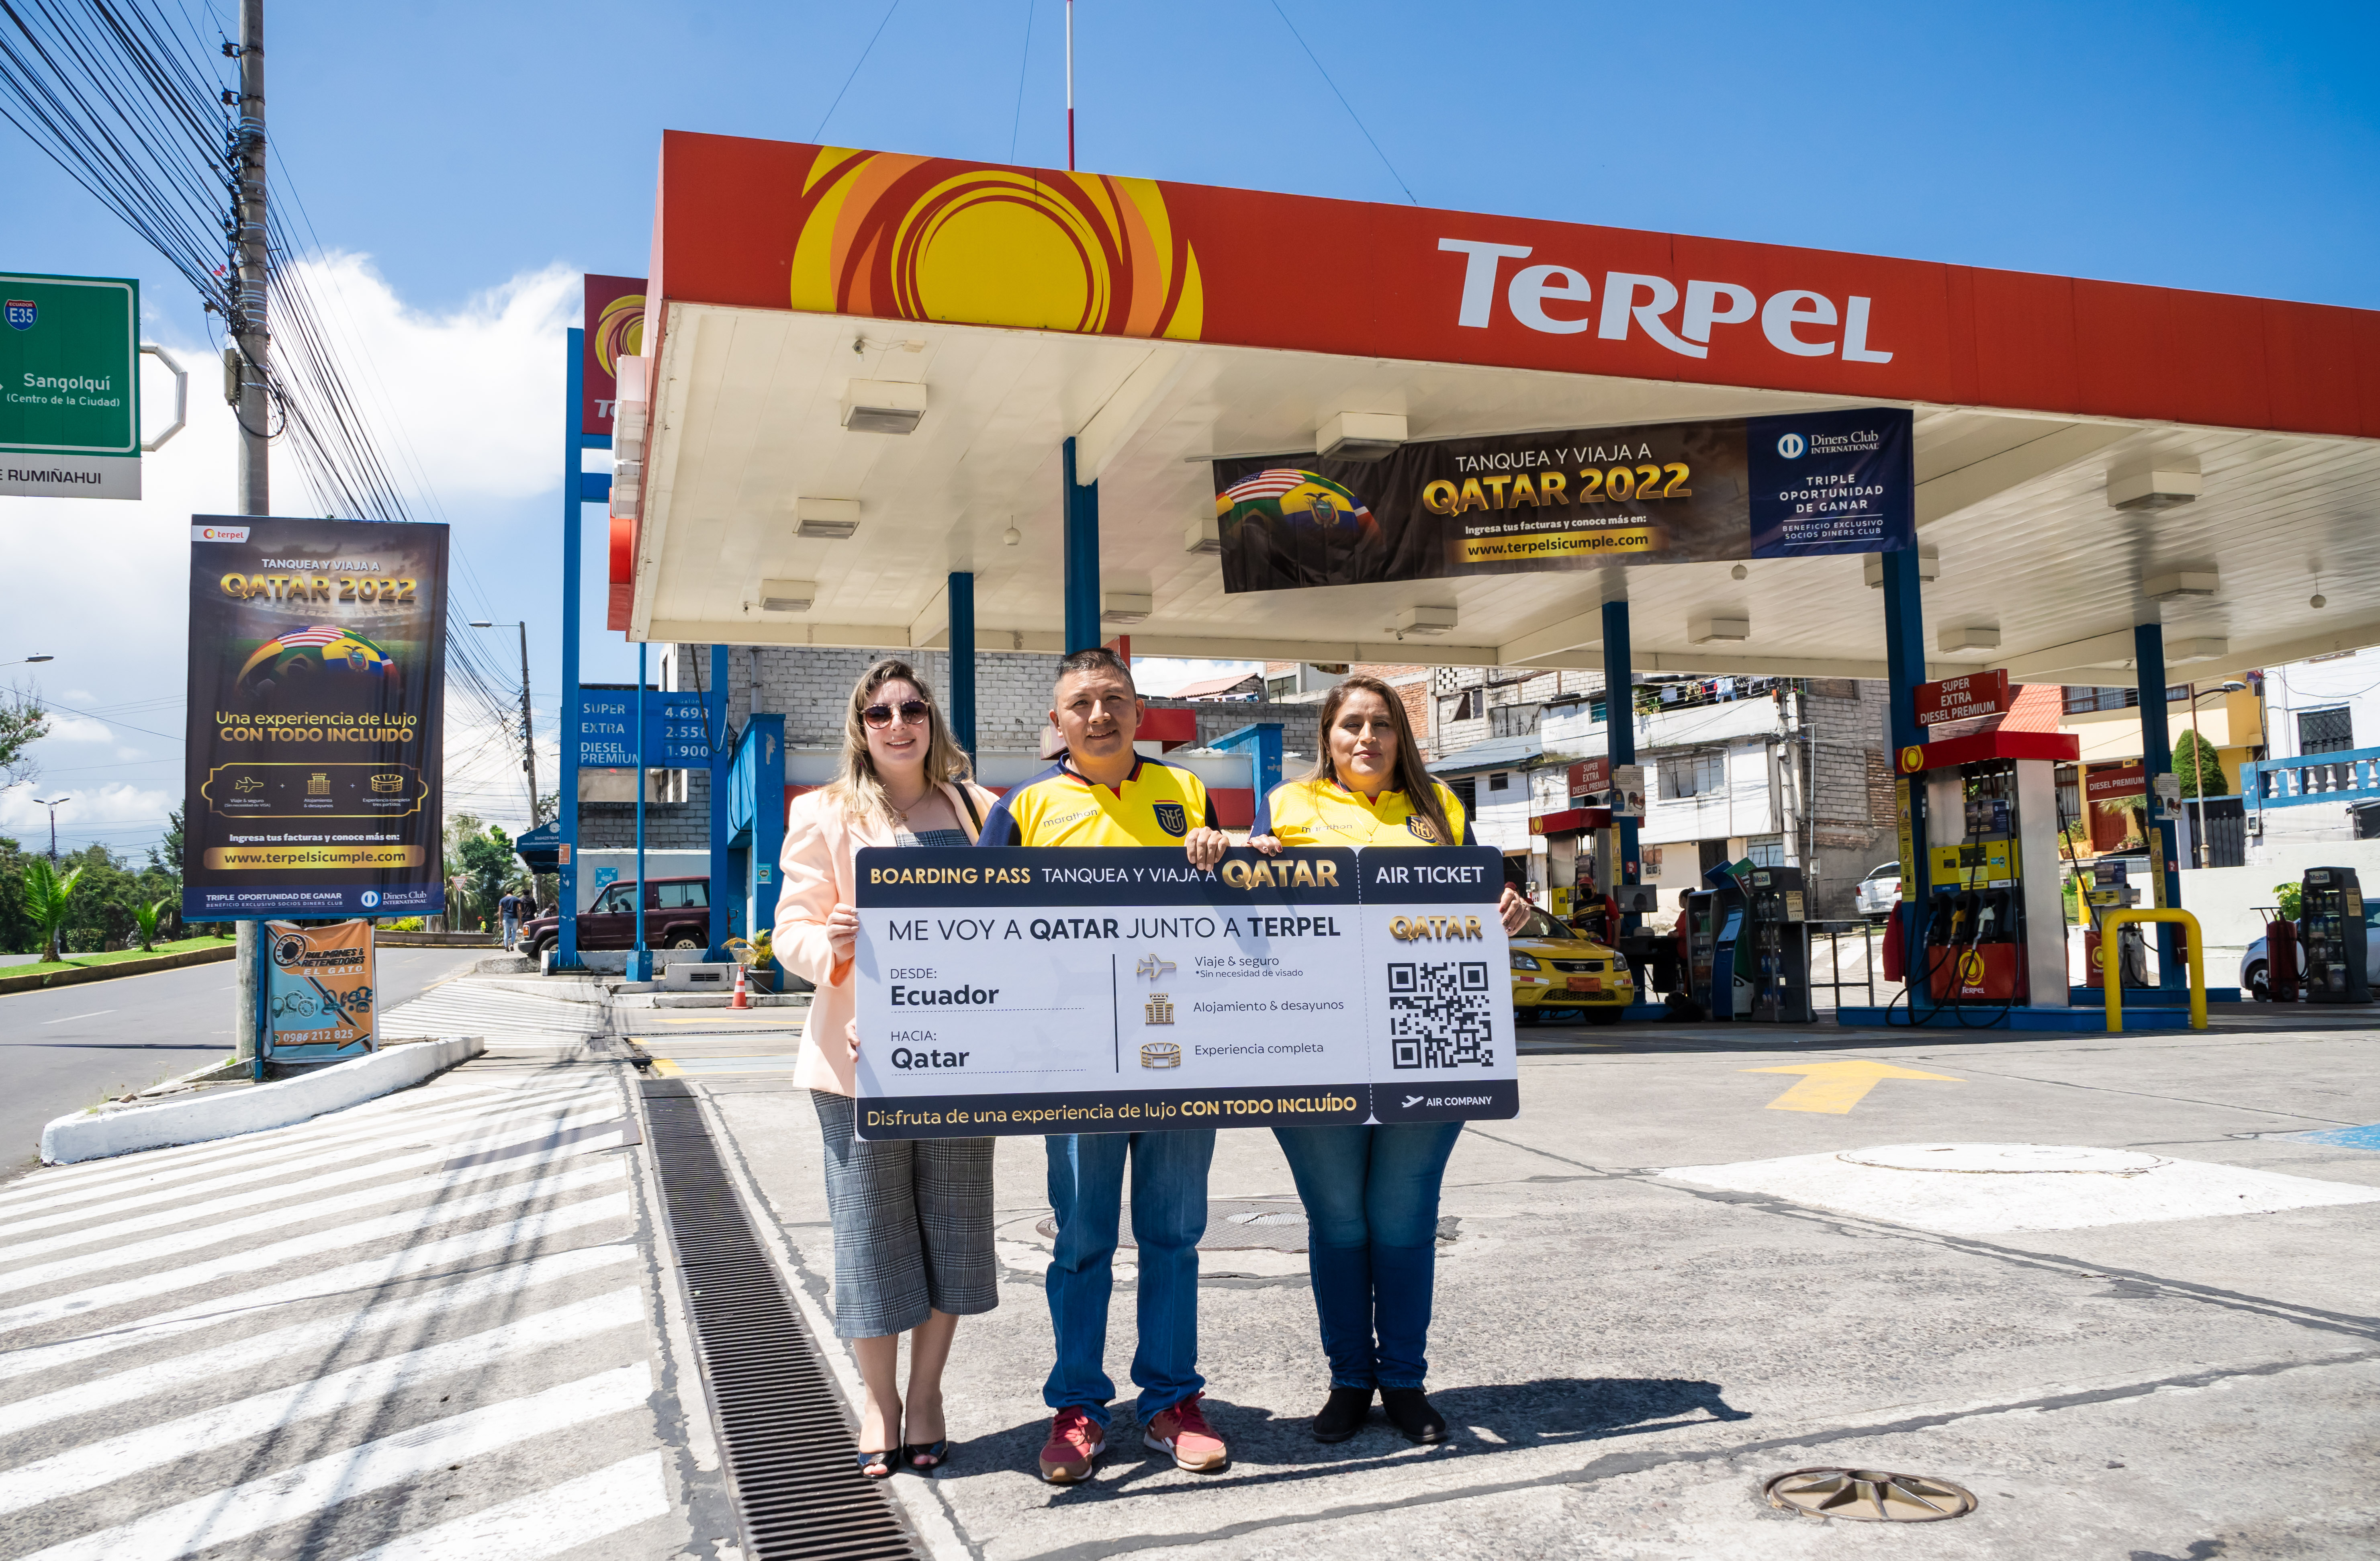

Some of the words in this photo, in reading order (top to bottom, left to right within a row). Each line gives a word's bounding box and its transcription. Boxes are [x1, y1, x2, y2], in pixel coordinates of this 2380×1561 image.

[10, 308, 33, 323] E35
[24, 373, 110, 393] Sangolquí
[7, 394, 47, 403] (Centro
[51, 396, 63, 404] de
[67, 396, 76, 405] la
[79, 397, 120, 407] Ciudad)
[1811, 434, 1848, 446] Diners
[1851, 430, 1878, 442] Club
[1811, 443, 1878, 454] INTERNATIONAL
[1456, 450, 1551, 472] TANQUEA
[1555, 449, 1568, 464] Y
[1574, 444, 1632, 462] VIAJA
[1638, 443, 1652, 459] A
[8, 469, 101, 484] RUMIÑAHUI
[1806, 474, 1855, 486] TRIPLE
[1423, 471, 1569, 517] QATAR
[1580, 462, 1692, 503] 2022
[1779, 485, 1883, 501] OPORTUNIDAD
[1796, 503, 1813, 513] DE
[1819, 500, 1868, 511] GANAR
[1465, 524, 1501, 536] Ingresa
[1503, 522, 1519, 532] tus
[1520, 520, 1562, 531] facturas
[1563, 520, 1570, 529] y
[1571, 517, 1606, 527] conoce
[1608, 515, 1629, 525] más
[1630, 515, 1646, 524] en:
[1783, 523, 1830, 532] BENEFICIO
[1834, 520, 1883, 528] EXCLUSIVO
[217, 531, 244, 540] terpel
[1468, 535, 1649, 556] www.terpelsicumple.com
[262, 559, 319, 570] TANQUEA
[322, 561, 331, 570] Y
[333, 561, 368, 571] VIAJA
[371, 562, 380, 571] A
[220, 573, 330, 600] QATAR
[339, 576, 417, 601] 2022
[1942, 677, 1970, 693] SUPER
[1941, 691, 1972, 707] EXTRA
[583, 703, 625, 714] SUPER
[1920, 709, 1950, 724] DIESEL
[1952, 701, 1995, 718] PREMIUM
[216, 711, 250, 724] Una
[255, 712, 354, 727] experiencia
[358, 712, 380, 725] de
[384, 712, 417, 728] Lujo
[220, 727, 263, 741] CON
[268, 727, 323, 742] TODO
[327, 728, 413, 742] INCLUIDO
[582, 722, 625, 734] EXTRA
[581, 742, 625, 753] DIESEL
[667, 745, 708, 757] 1.900
[1583, 762, 1598, 772] SUPER
[1583, 771, 1599, 782] EXTRA
[2090, 781, 2112, 791] DIESEL
[2112, 776, 2145, 788] PREMIUM
[1572, 784, 1588, 795] DIESEL
[1043, 809, 1098, 827] marathon
[1302, 823, 1352, 833] marathon
[229, 834, 265, 843] Ingresa
[366, 833, 384, 841] más
[225, 851, 405, 864] www.terpelsicumple.com
[871, 867, 978, 884] BOARDING
[985, 867, 1031, 884] PASS
[1042, 868, 1129, 884] TANQUEA
[1133, 868, 1144, 882] Y
[1149, 868, 1201, 882] VIAJA
[1206, 869, 1217, 882] A
[1222, 859, 1339, 890] QATAR
[1376, 867, 1410, 883] AIR
[1413, 866, 1484, 883] TICKET
[1754, 874, 1769, 883] Mobil
[408, 891, 427, 899] Club
[889, 920, 928, 941] ME
[937, 919, 996, 941] VOY
[1004, 919, 1022, 940] A
[1030, 918, 1120, 941] QATAR
[1126, 917, 1215, 938] JUNTO
[1223, 917, 1241, 937] A
[1247, 917, 1341, 937] TERPEL
[1389, 915, 1483, 941] QATAR
[305, 947, 357, 959] RULIMANES
[358, 947, 364, 955] &
[302, 955, 365, 967] RETENEDORES
[1195, 956, 1225, 968] Viaje
[1228, 957, 1236, 966] &
[1239, 957, 1279, 968] seguro
[328, 965, 362, 974] GATO
[890, 968, 937, 979] DESDE:
[1216, 969, 1260, 977] necesidad
[1262, 969, 1274, 977] de
[1276, 969, 1303, 977] visado
[891, 984, 1000, 1006] Ecuador
[1193, 1001, 1267, 1014] Alojamiento
[1270, 1001, 1278, 1011] &
[1281, 1000, 1344, 1013] desayunos
[283, 1032, 309, 1042] 0986
[311, 1031, 331, 1040] 212
[334, 1029, 353, 1039] 825
[891, 1031, 937, 1042] HACIA:
[1195, 1044, 1265, 1057] Experiencia
[1268, 1043, 1324, 1056] completa
[891, 1047, 970, 1071] Qatar
[1426, 1097, 1442, 1106] AIR
[1444, 1096, 1492, 1106] COMPANY
[867, 1109, 941, 1125] Disfruta
[946, 1109, 969, 1124] de
[974, 1110, 1007, 1123] una
[1012, 1103, 1114, 1123] experiencia
[1118, 1103, 1140, 1118] de
[1145, 1102, 1176, 1120] lujo
[1181, 1100, 1219, 1116] CON
[1223, 1099, 1274, 1115] TODO
[1278, 1092, 1357, 1113] INCLUÍDO
